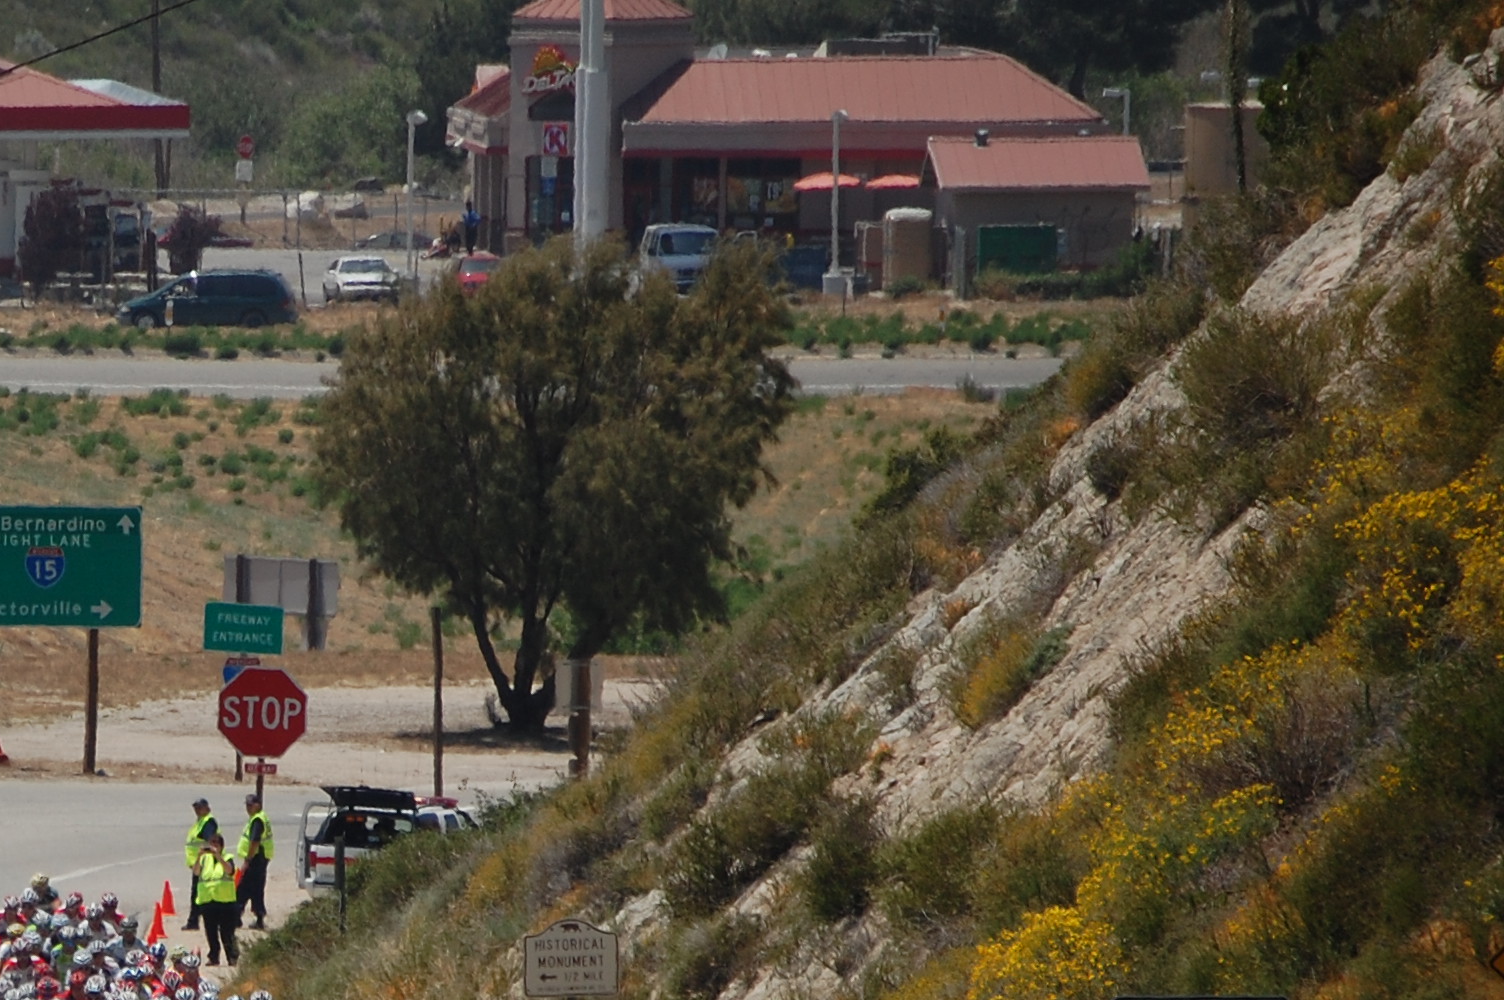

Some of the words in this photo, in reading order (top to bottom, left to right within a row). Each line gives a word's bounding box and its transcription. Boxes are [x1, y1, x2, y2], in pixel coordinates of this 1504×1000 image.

[1, 516, 106, 532] Bernardino
[49, 534, 91, 547] LANE
[35, 560, 57, 580] 15
[217, 612, 271, 626] FREEWAY
[212, 631, 274, 646] ENTRANCE
[222, 696, 302, 730] STOP
[534, 937, 605, 952] HISTORICAL
[538, 955, 603, 969] MONUMENT
[564, 973, 579, 984] 1/2
[583, 972, 603, 982] MILE
